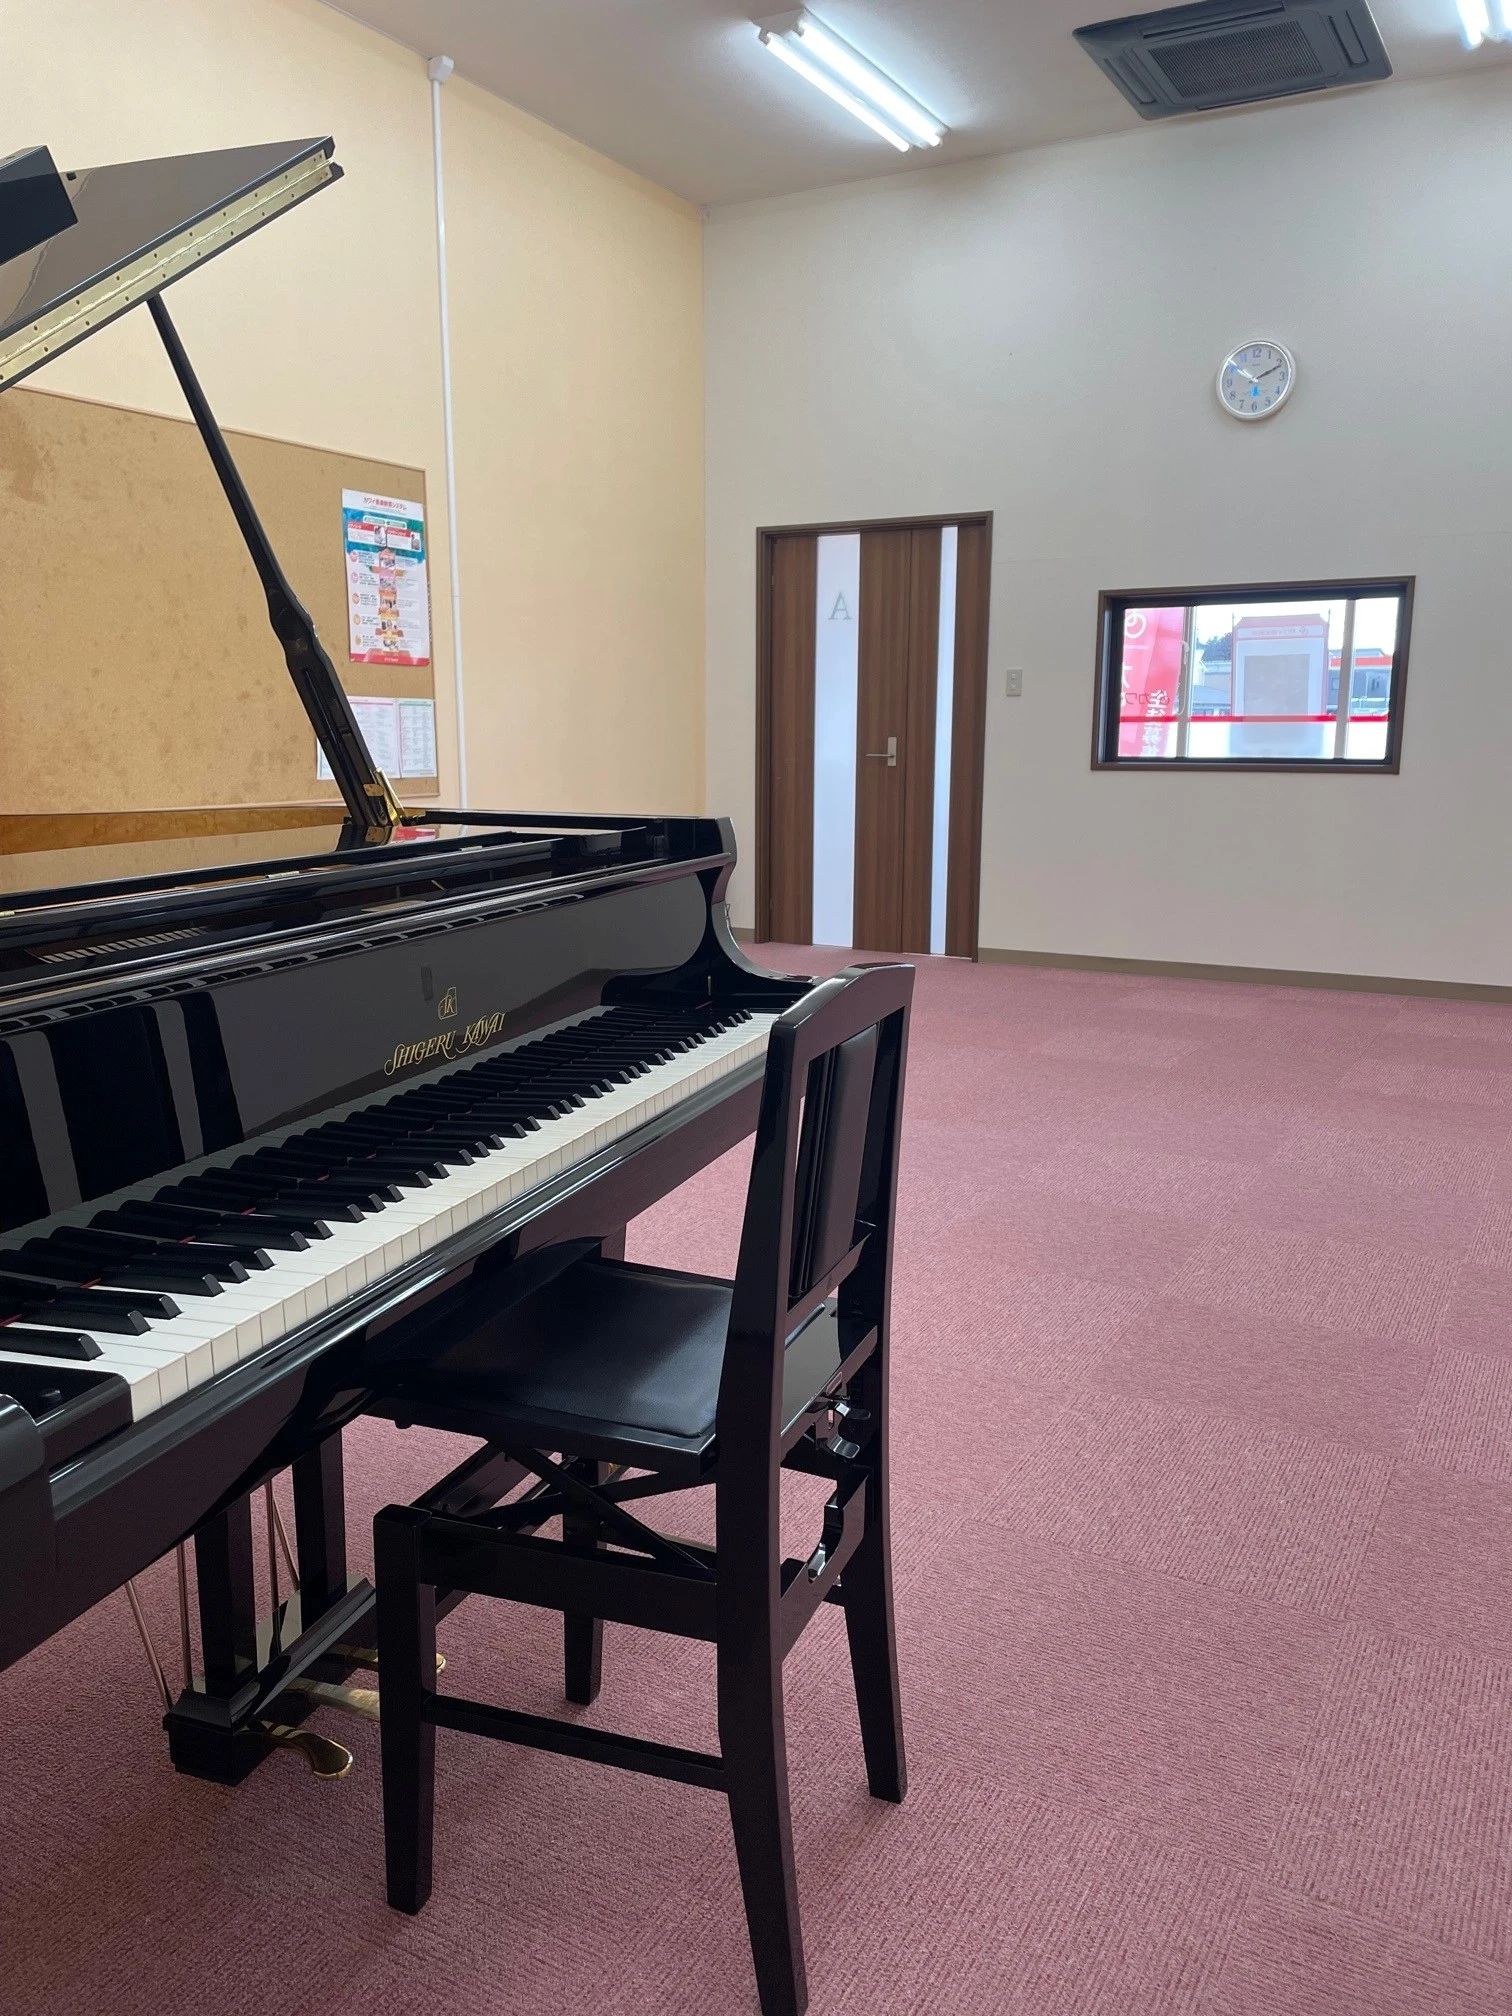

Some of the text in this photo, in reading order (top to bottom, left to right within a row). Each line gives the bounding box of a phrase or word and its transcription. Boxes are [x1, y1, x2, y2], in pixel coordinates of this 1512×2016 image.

[1252, 347, 1262, 358] 12
[1279, 371, 1285, 381] 3
[1226, 378, 1233, 387] 9
[1229, 391, 1236, 400] 8
[1239, 399, 1245, 409] 7
[1251, 401, 1258, 412] 6
[828, 591, 851, 620] A
[384, 1011, 506, 1075] SHIGERU KAWAI
